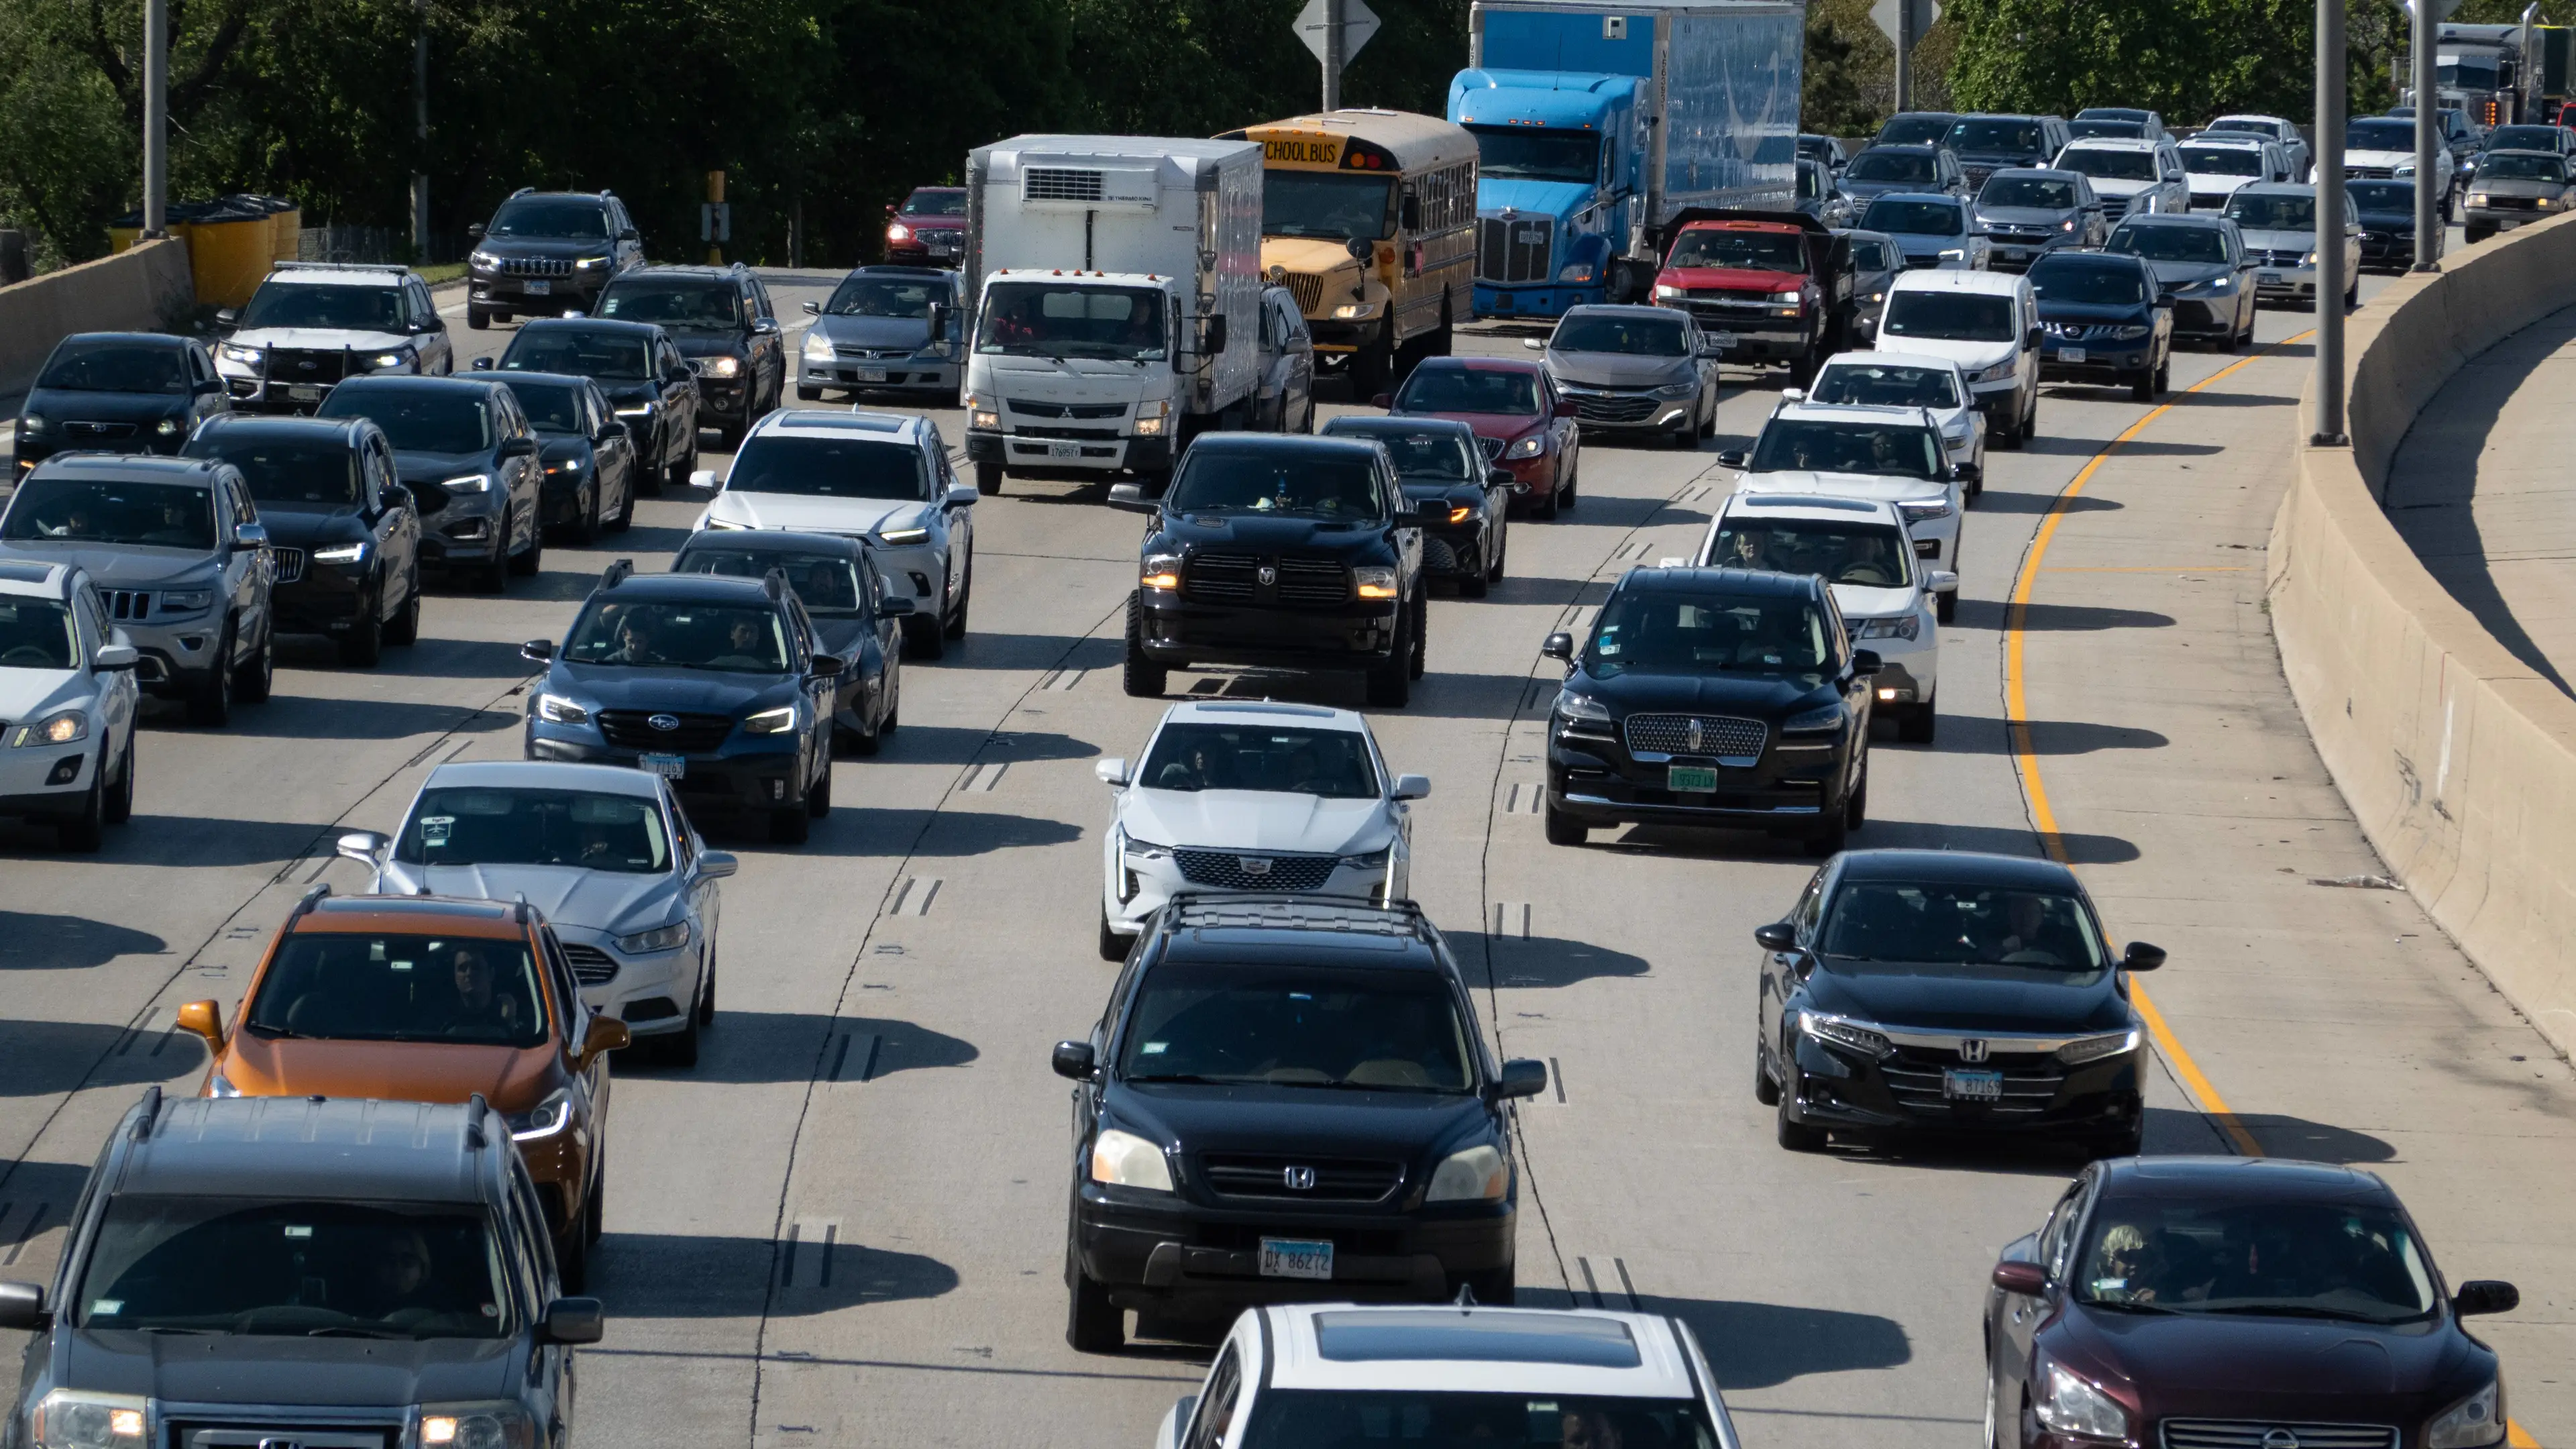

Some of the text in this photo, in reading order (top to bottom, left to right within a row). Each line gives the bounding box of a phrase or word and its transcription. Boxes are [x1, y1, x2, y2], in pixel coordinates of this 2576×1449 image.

[1261, 140, 1336, 163] CHOOL BUS
[1288, 1252, 1329, 1272] 86272
